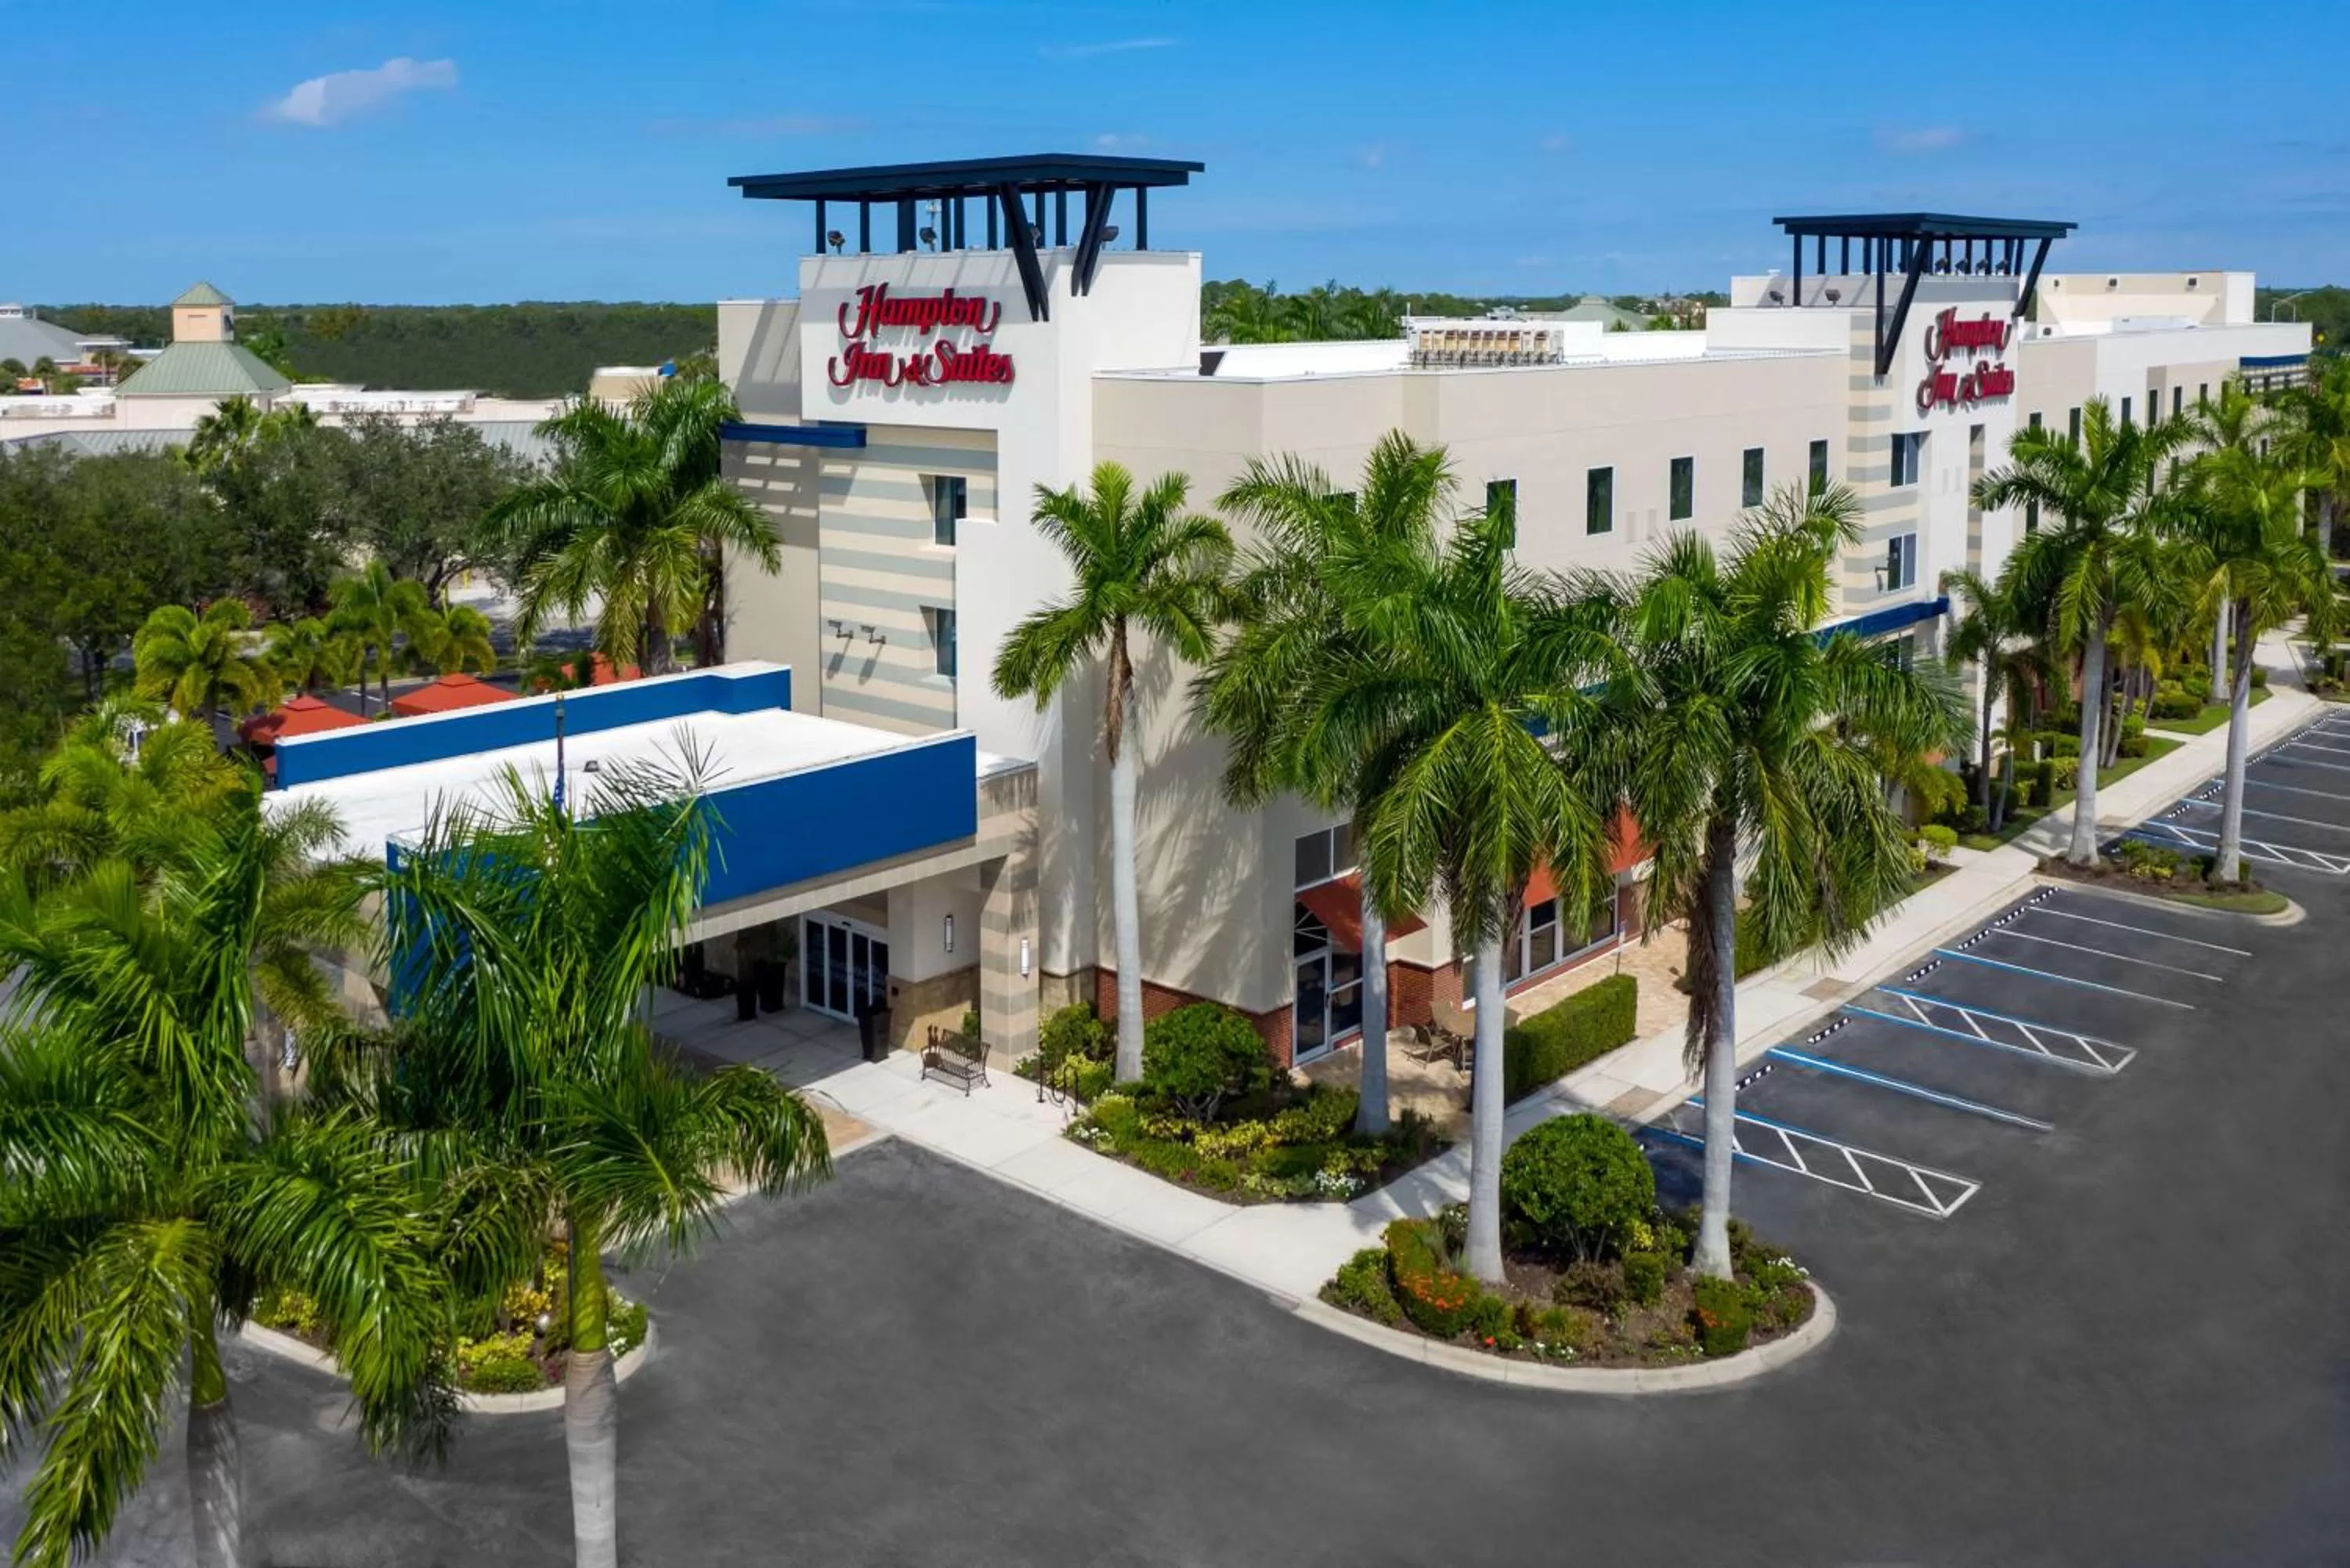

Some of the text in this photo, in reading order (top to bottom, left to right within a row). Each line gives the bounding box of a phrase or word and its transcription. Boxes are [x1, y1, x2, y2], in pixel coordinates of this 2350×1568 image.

[838, 282, 1001, 338] Hampton
[1925, 306, 2012, 360] Hampton
[828, 339, 1014, 387] Inn & Suites
[1916, 365, 1964, 409] Inn
[1973, 360, 2015, 399] Suites
